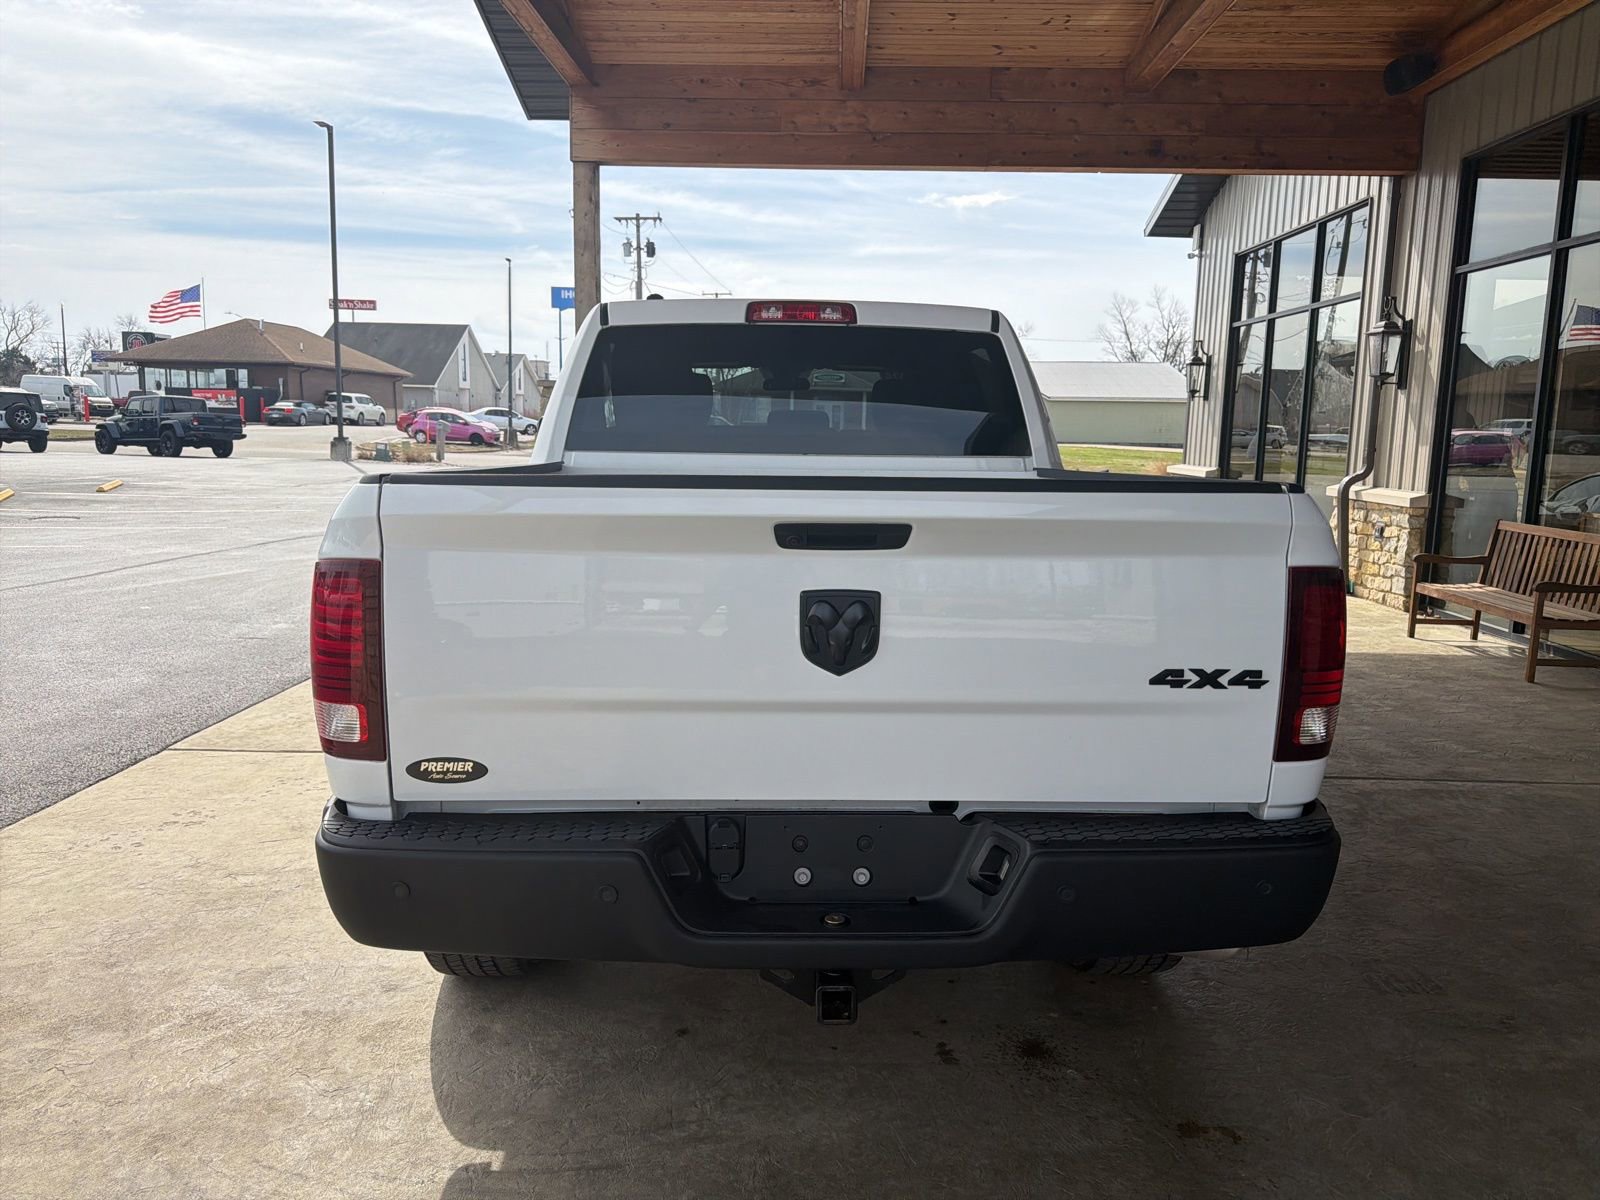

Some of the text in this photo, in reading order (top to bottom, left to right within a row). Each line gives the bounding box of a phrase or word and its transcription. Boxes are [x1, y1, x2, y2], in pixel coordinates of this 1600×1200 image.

[561, 289, 575, 299] IH
[1149, 668, 1270, 689] 4X4
[420, 761, 474, 772] PREMIER
[444, 772, 466, 780] Source
